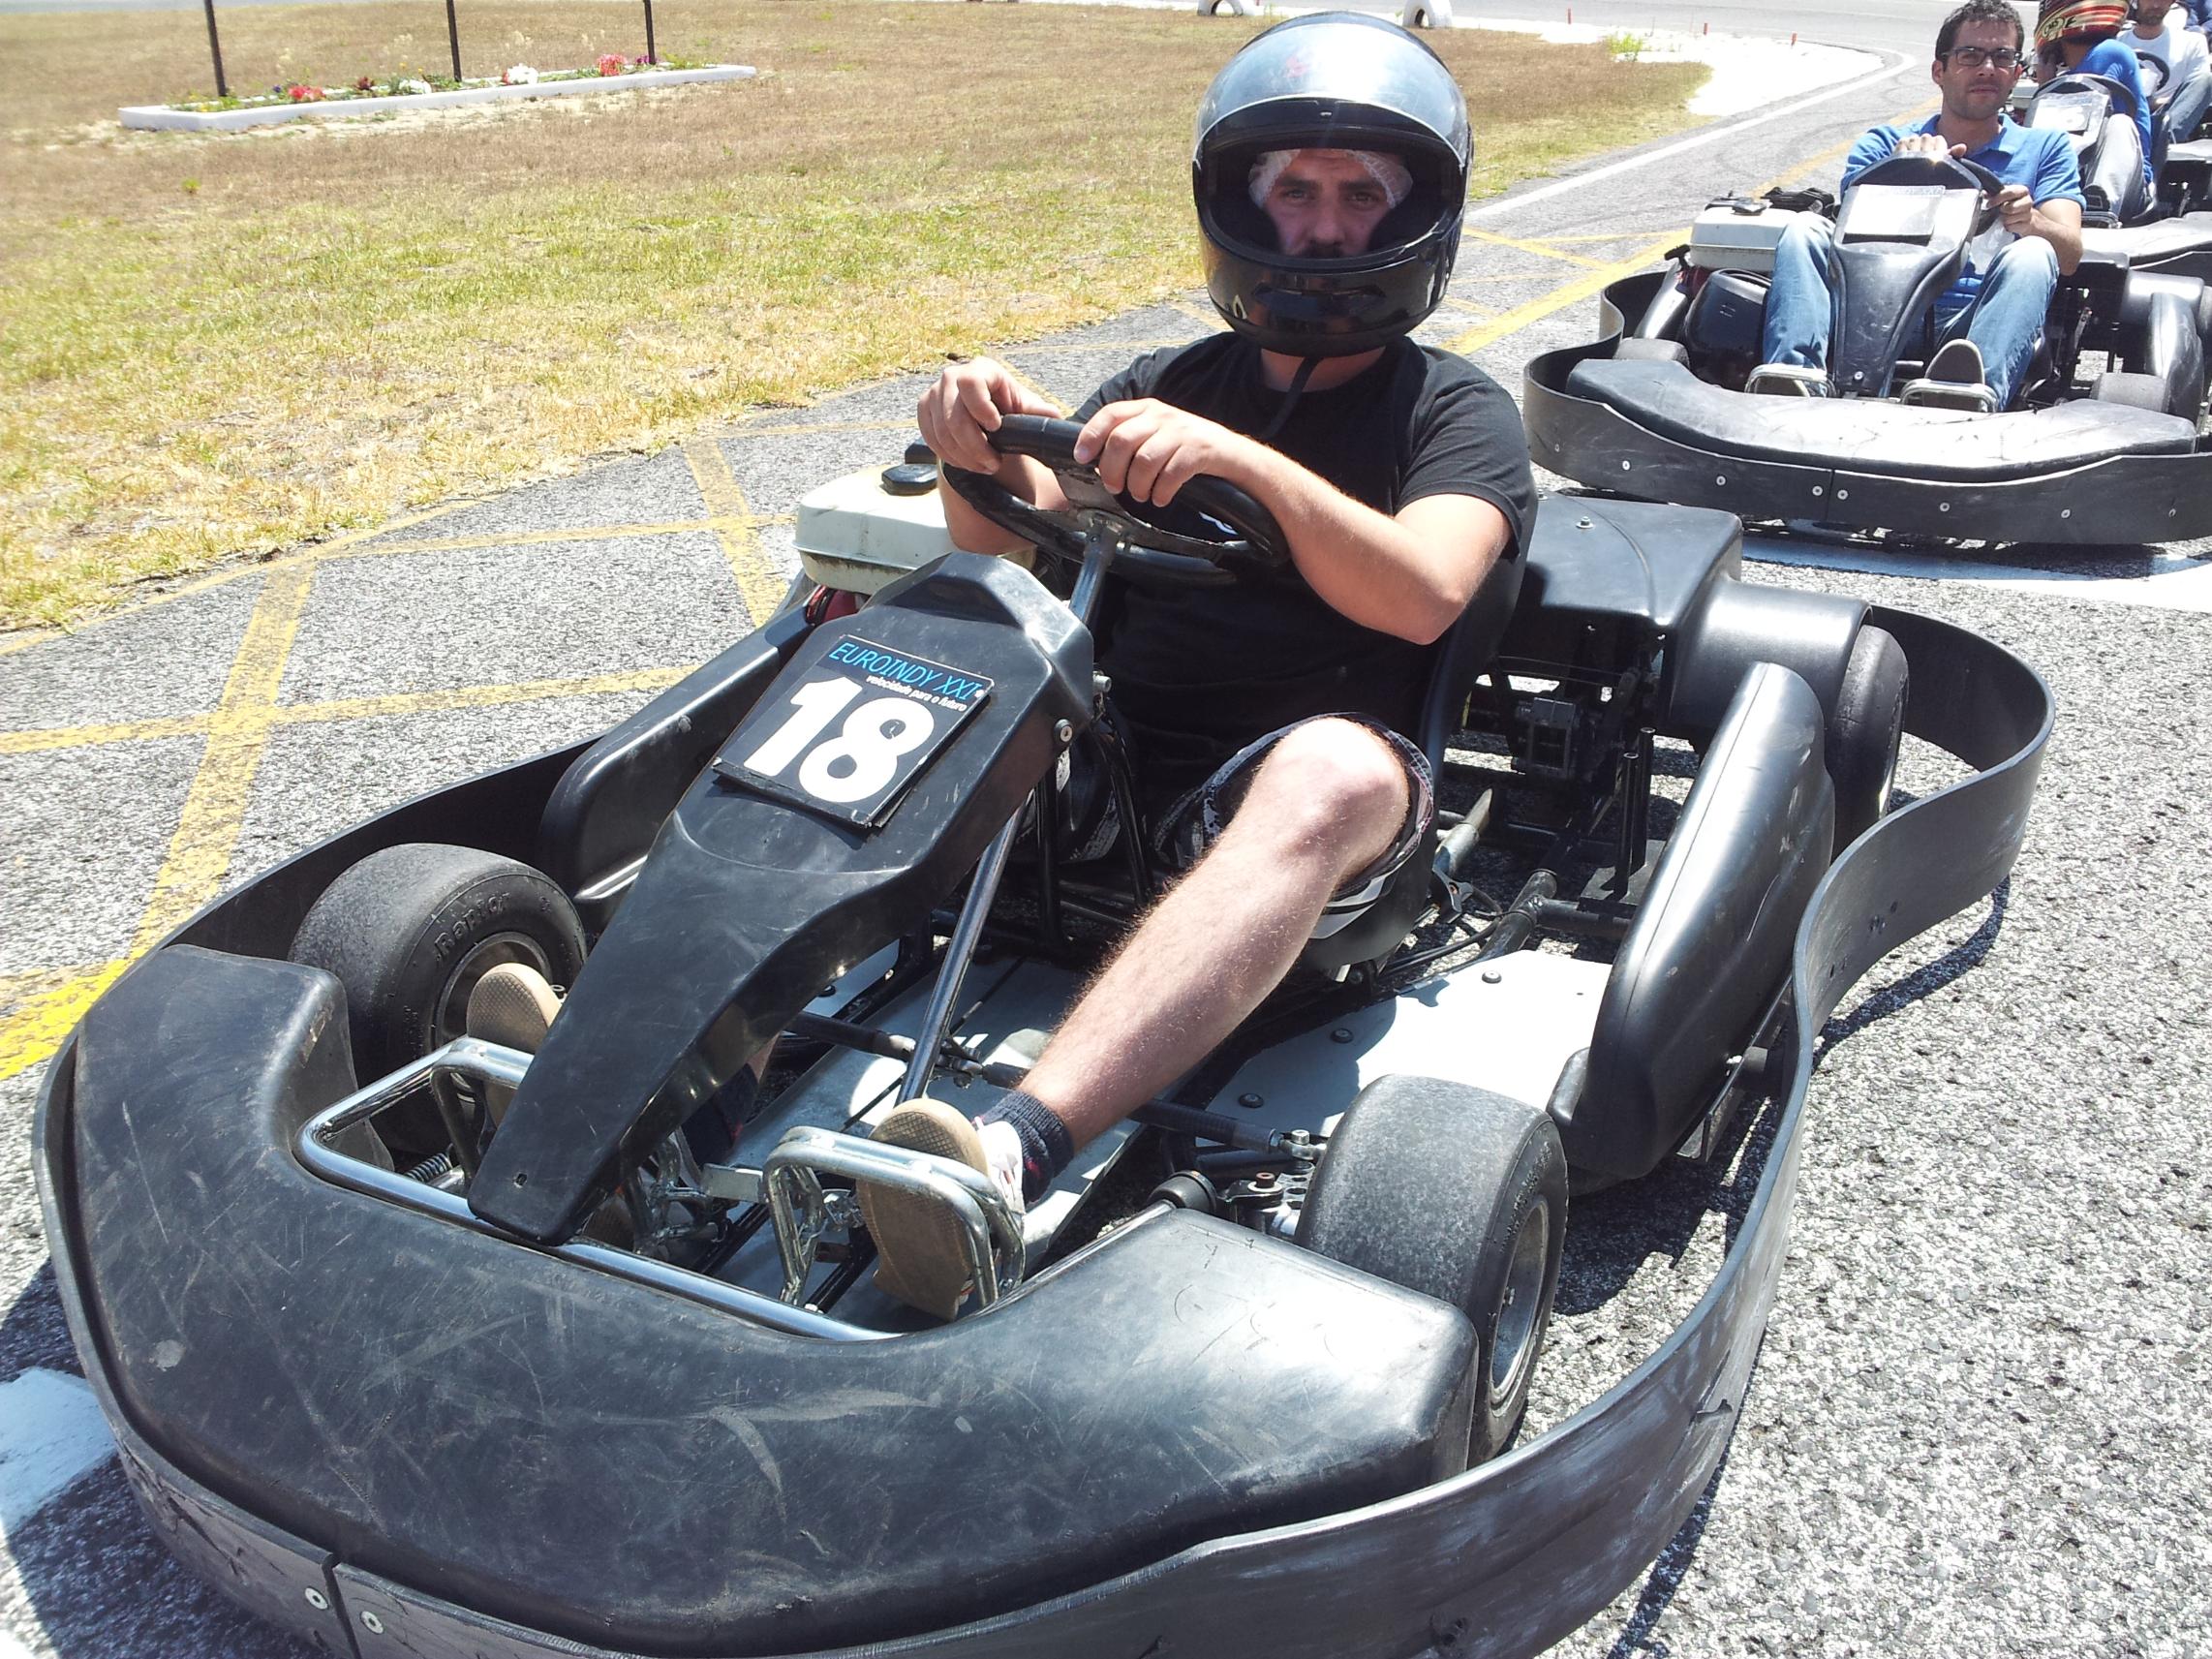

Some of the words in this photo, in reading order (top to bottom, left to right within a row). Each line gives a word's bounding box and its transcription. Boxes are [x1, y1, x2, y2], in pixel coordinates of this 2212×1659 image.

[829, 642, 943, 688] EUROINDY
[933, 675, 983, 700] XXI
[866, 674, 913, 695] velocidade
[908, 689, 931, 703] para
[931, 694, 938, 704] o
[937, 695, 968, 712] futuro
[743, 676, 935, 803] 18
